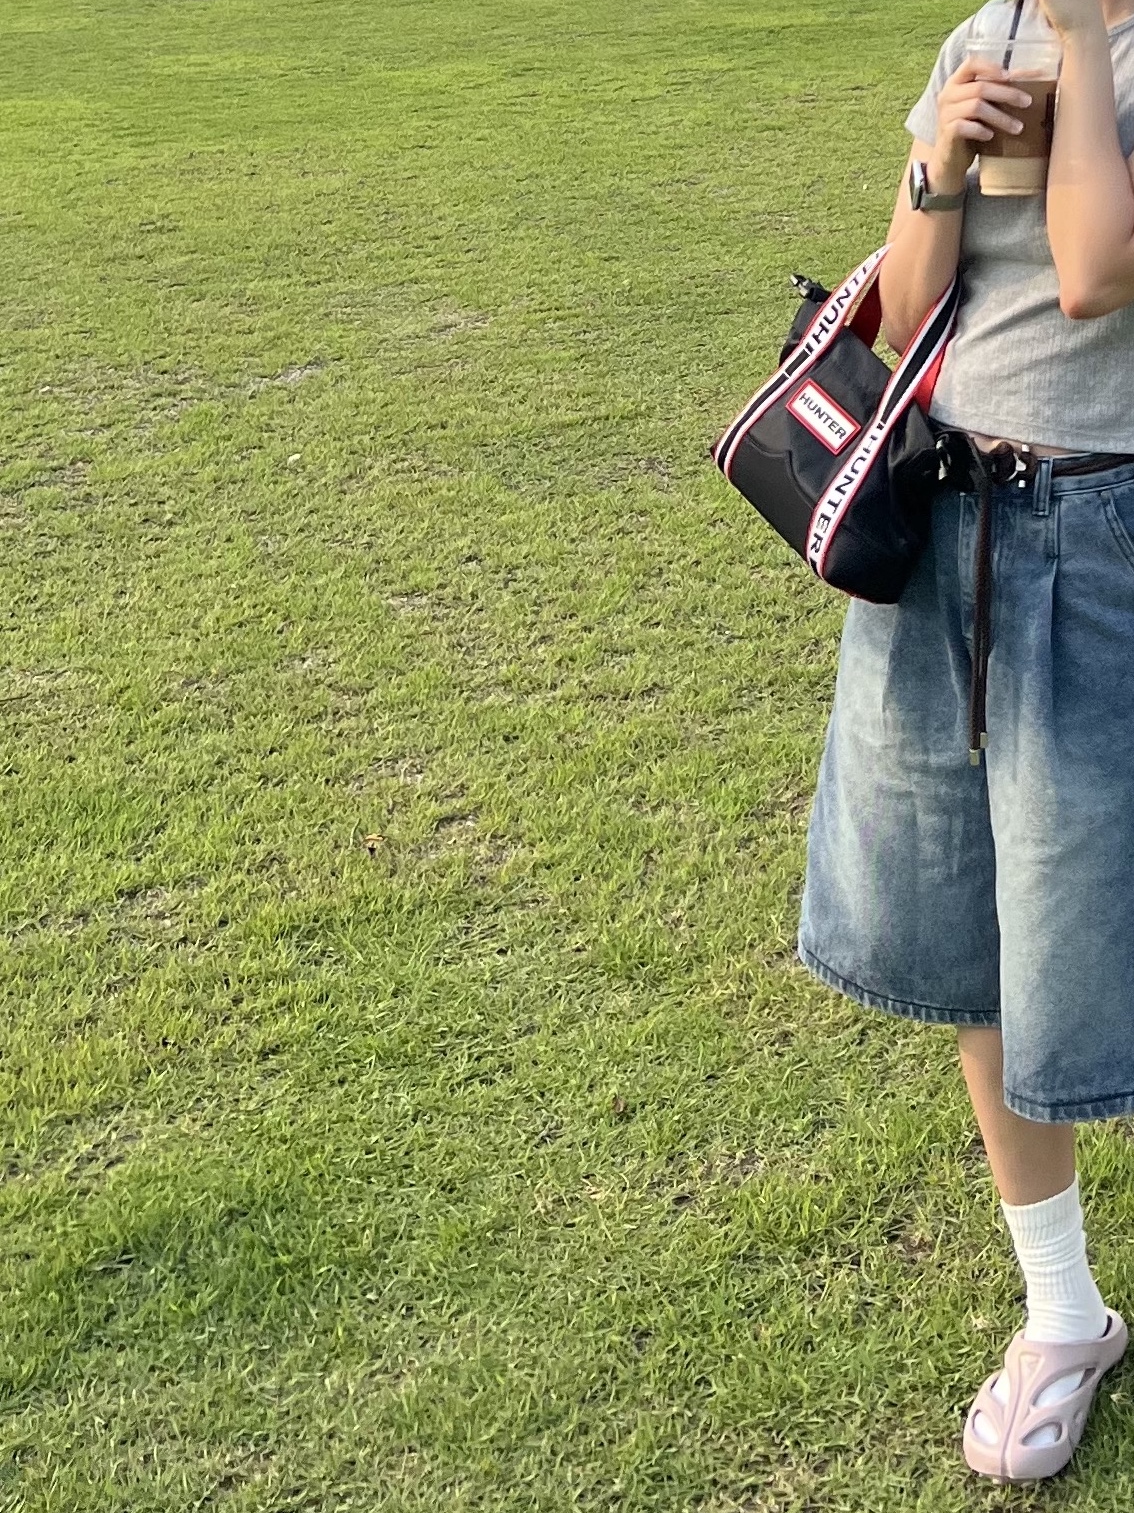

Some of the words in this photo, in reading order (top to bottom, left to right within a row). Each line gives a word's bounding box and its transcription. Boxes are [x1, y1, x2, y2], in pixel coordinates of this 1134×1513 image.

[812, 246, 886, 345] HUNTE
[799, 393, 847, 440] HUNTER
[810, 434, 878, 554] HUNTER
